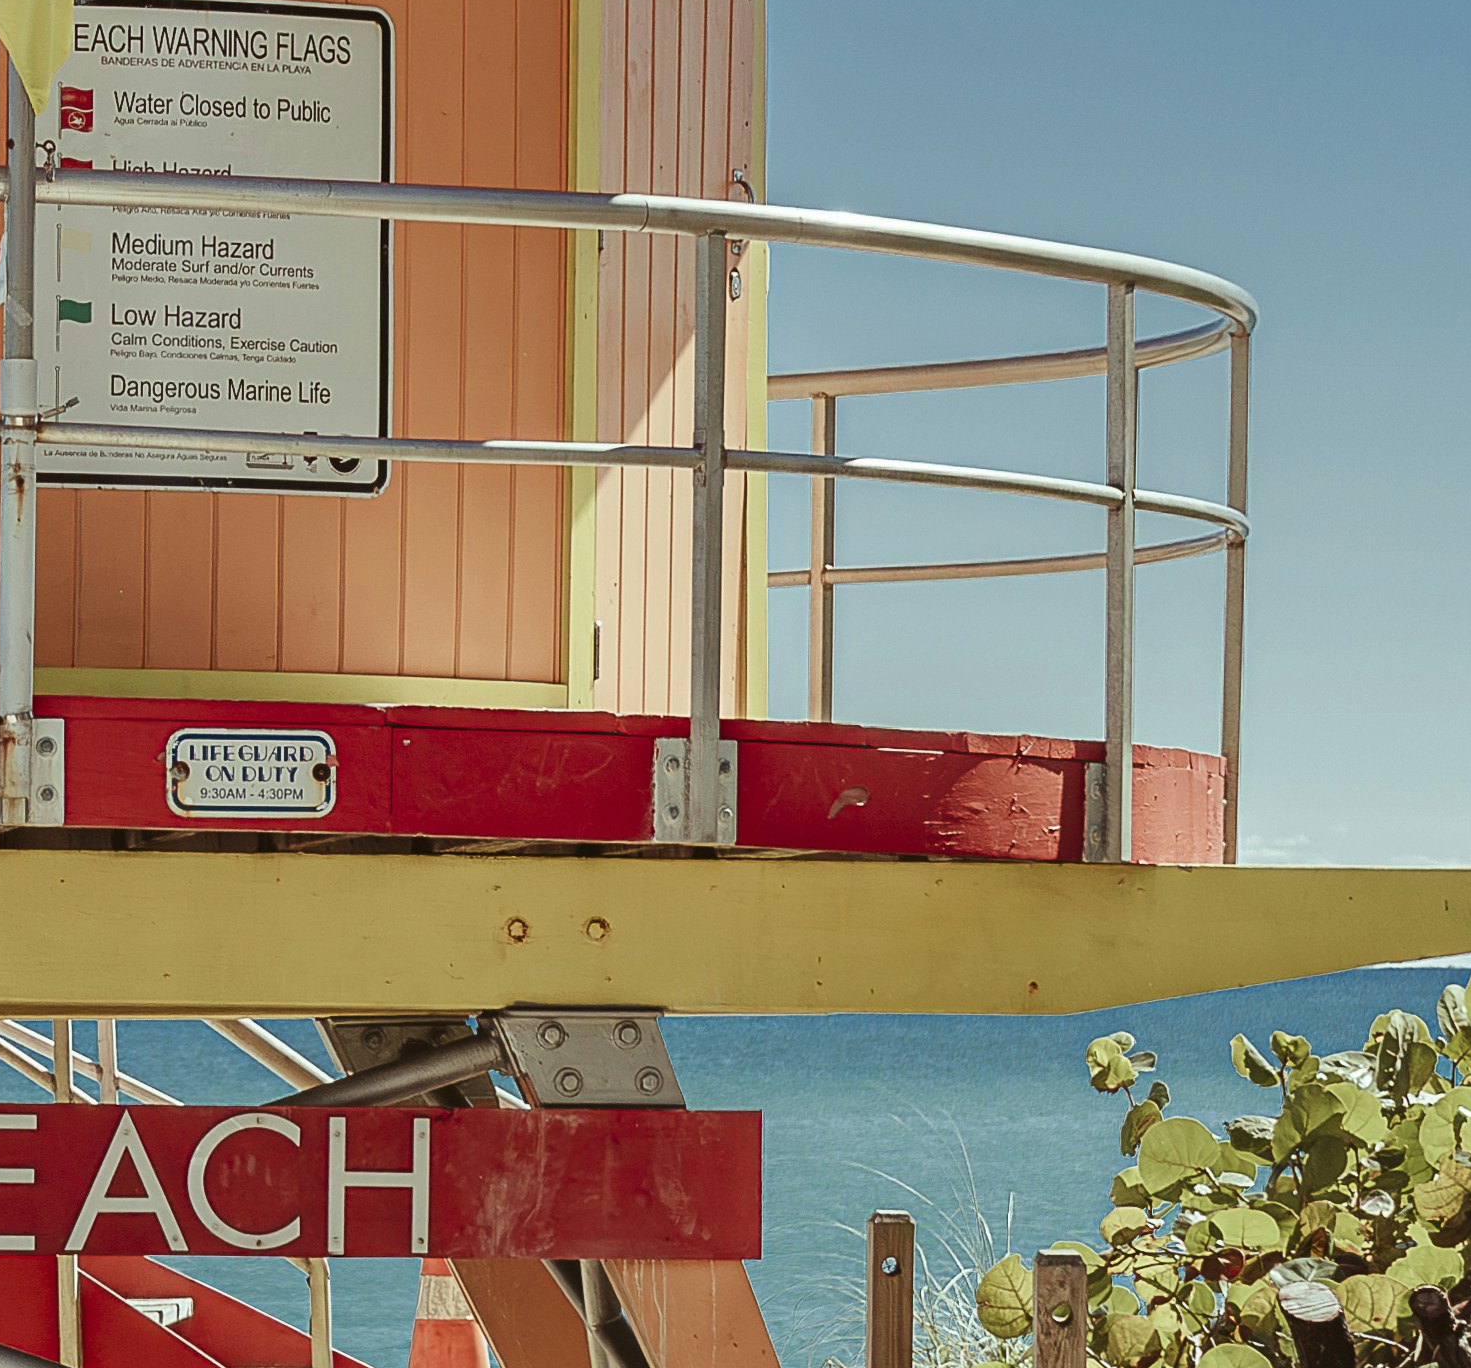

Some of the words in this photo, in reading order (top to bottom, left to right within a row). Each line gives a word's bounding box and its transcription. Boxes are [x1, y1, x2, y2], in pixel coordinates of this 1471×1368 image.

[74, 23, 144, 53] EACH
[152, 25, 268, 60] WARNING
[276, 32, 351, 65] FLAGS
[101, 56, 158, 67] BANDERAS
[161, 58, 175, 68] DE
[178, 59, 248, 71] ADVERTENCIA
[251, 62, 264, 72] EN
[267, 63, 279, 73] LA
[282, 64, 312, 75] PLAYA
[114, 91, 173, 114] Water
[179, 93, 246, 119] Closed
[253, 100, 270, 119] to
[277, 98, 331, 123] Public
[114, 117, 135, 127] Agua
[137, 117, 169, 127] Cerrada
[171, 118, 178, 127] al
[112, 232, 193, 257] Medium
[202, 235, 274, 260] Hazard
[112, 258, 177, 273] Moderate
[181, 260, 211, 273] Surf
[213, 261, 255, 276] and/or
[259, 264, 314, 279] Currents
[111, 274, 138, 284] Peligro
[168, 275, 198, 285] Resaca
[200, 277, 237, 287] Moderada
[252, 279, 290, 289] Corrientes
[292, 281, 320, 290] Fuertes
[112, 303, 157, 326] Low
[164, 305, 242, 330] Hazard
[111, 332, 147, 346] Calm
[152, 334, 226, 350] Conditions,
[231, 336, 286, 352] Exercise
[290, 339, 338, 354] Caution
[110, 349, 137, 359] Peligro
[242, 353, 264, 363] Tenga
[266, 355, 296, 363] Cuidado
[110, 374, 220, 403] Dangerous
[228, 378, 292, 403] Marine
[299, 381, 331, 404] Life
[110, 404, 128, 412] Vida
[130, 404, 158, 413] Marina
[160, 405, 197, 415] Peligrosa
[206, 765, 235, 782] ON
[242, 765, 298, 783] DUTY
[200, 787, 246, 800] 9:30AM
[258, 788, 304, 800] 4:30PM
